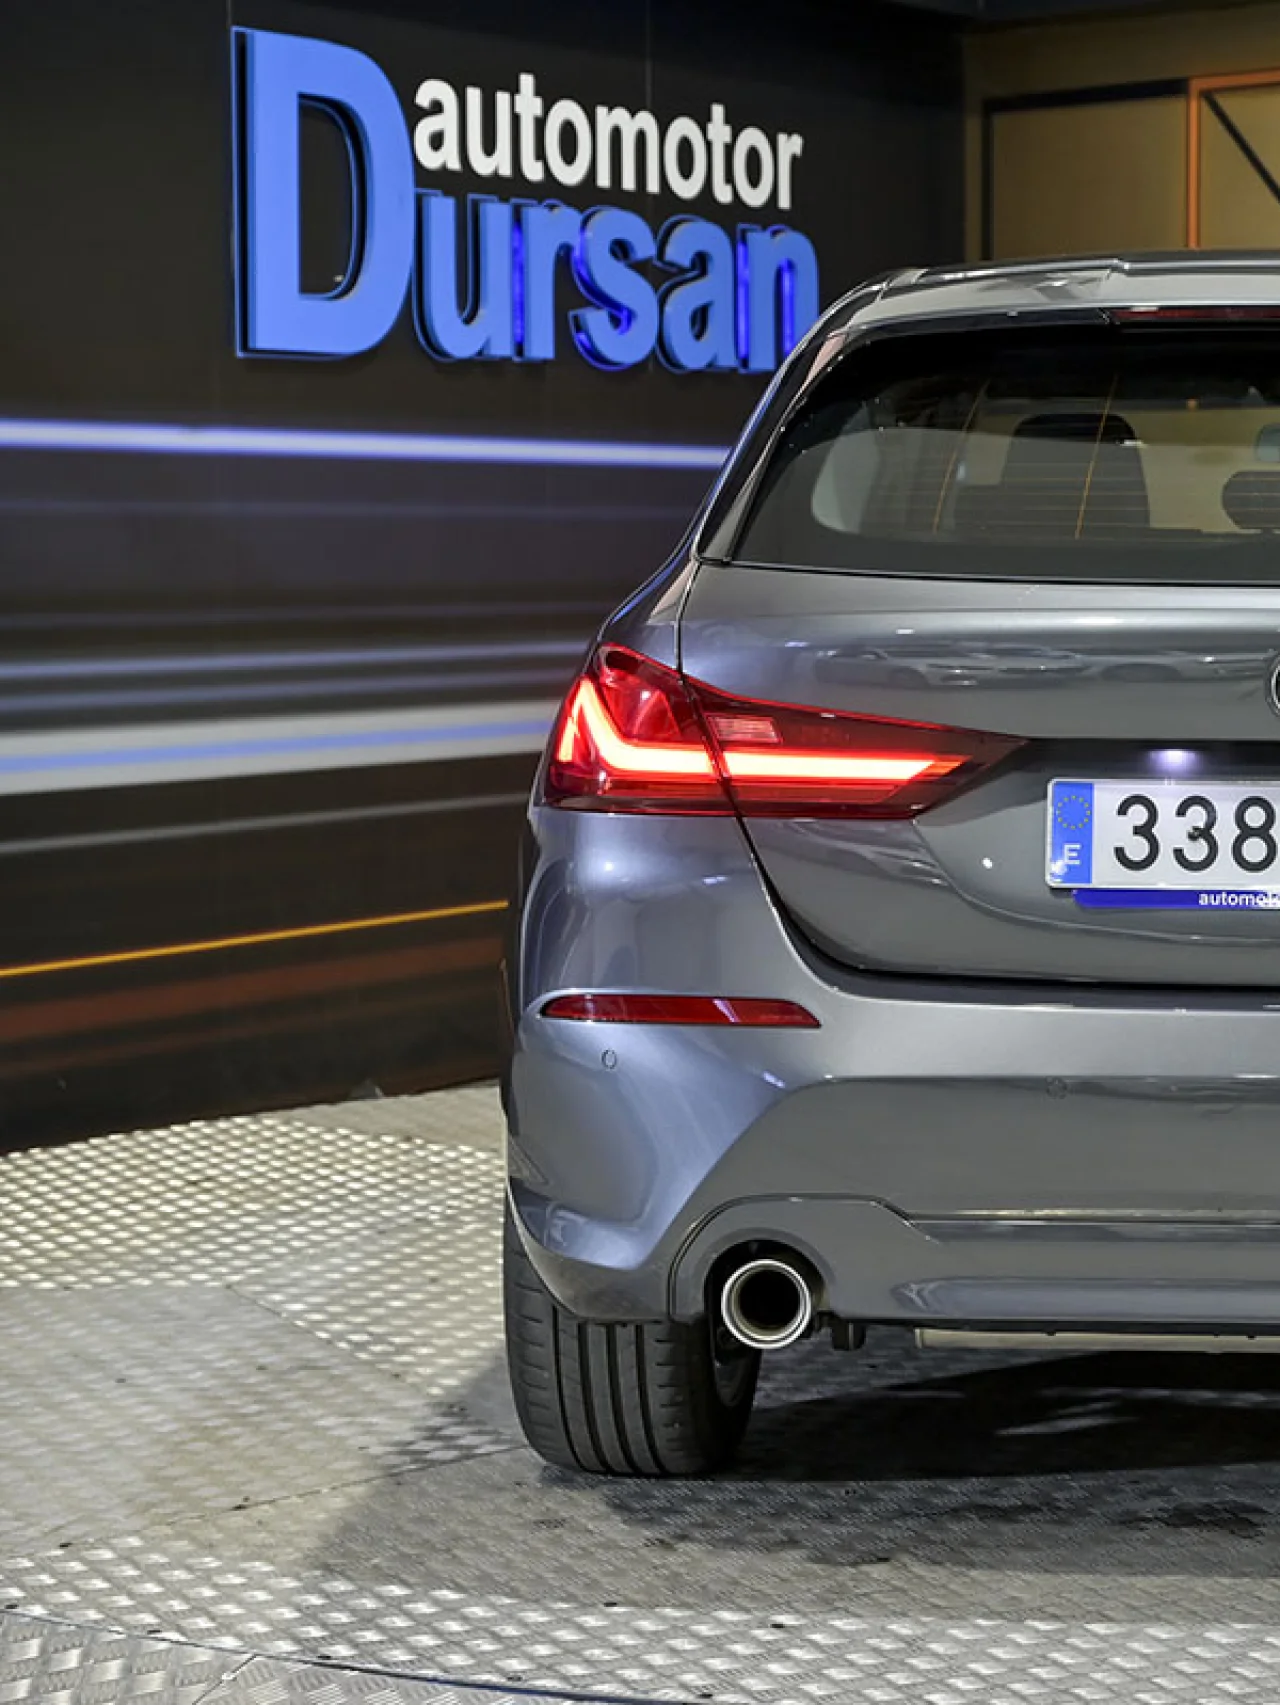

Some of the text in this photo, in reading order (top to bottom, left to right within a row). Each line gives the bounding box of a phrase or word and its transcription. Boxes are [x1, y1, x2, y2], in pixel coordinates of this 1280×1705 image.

[232, 26, 818, 373] Dursan
[413, 73, 802, 209] automotor
[1063, 844, 1080, 864] E
